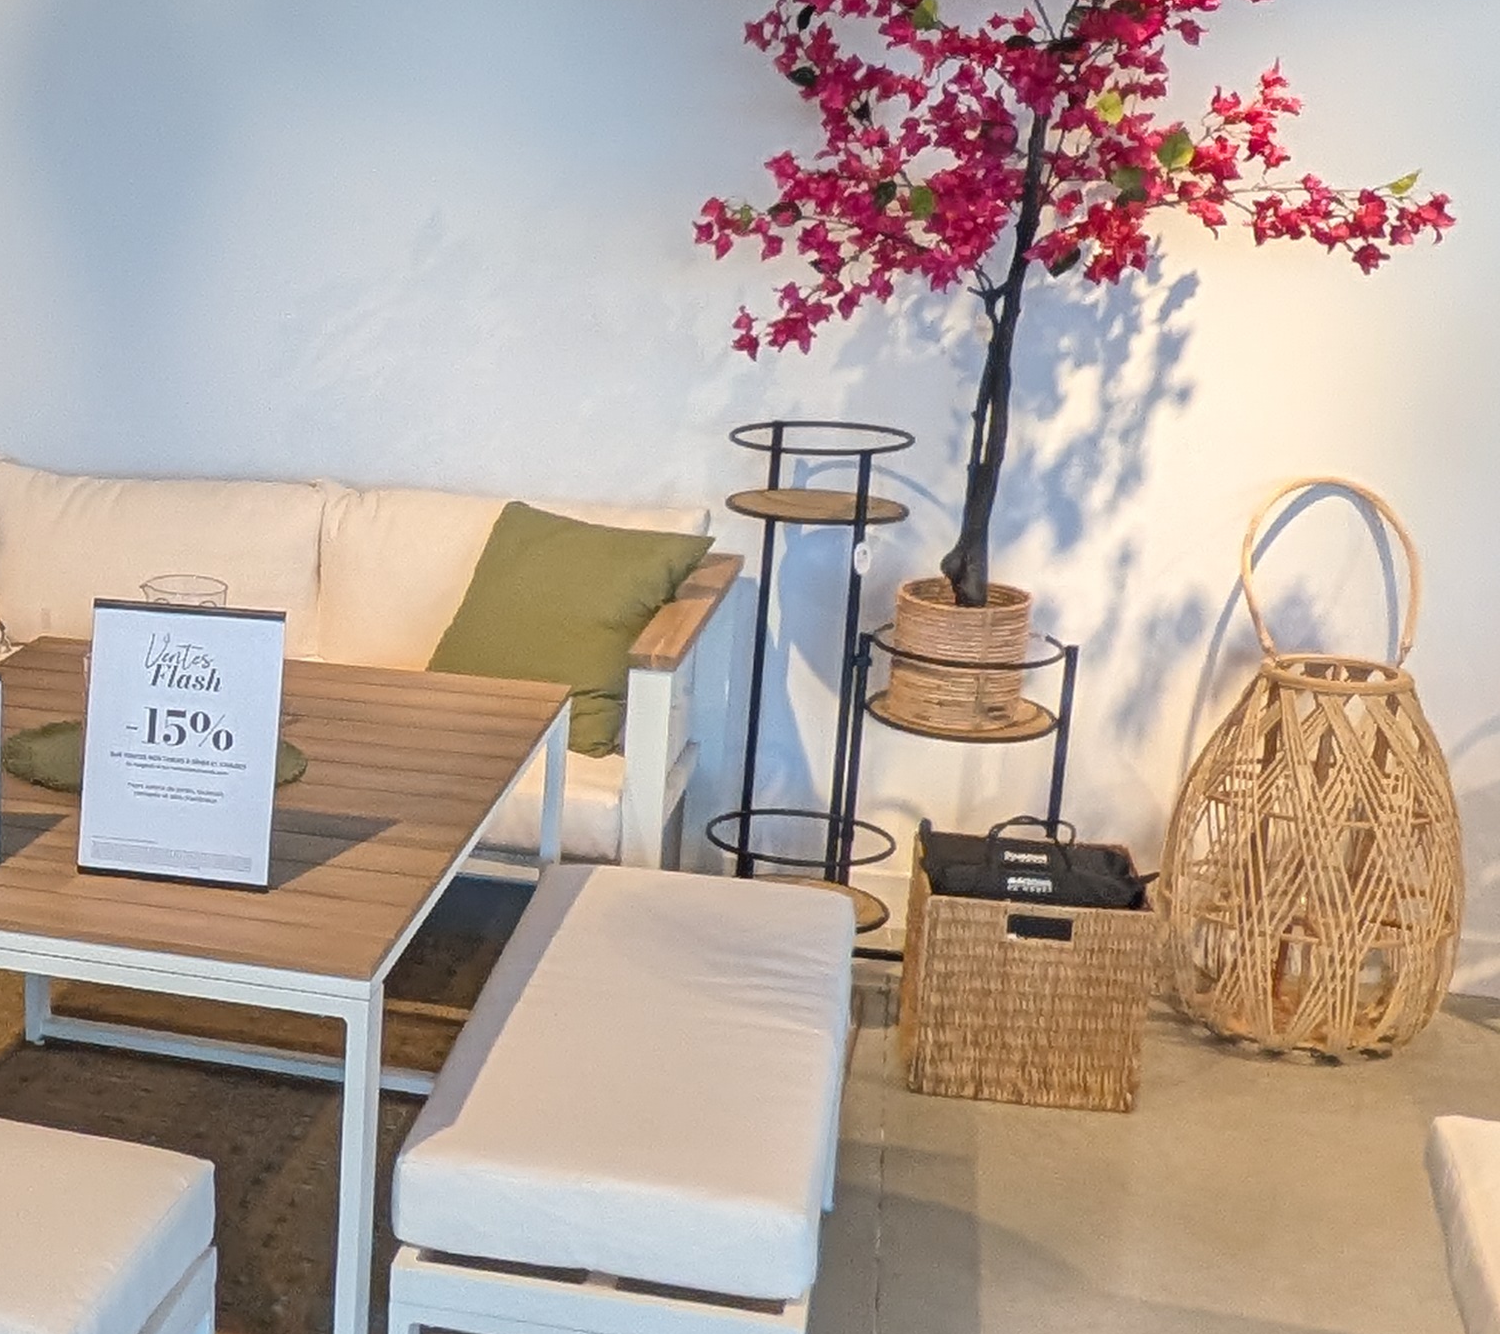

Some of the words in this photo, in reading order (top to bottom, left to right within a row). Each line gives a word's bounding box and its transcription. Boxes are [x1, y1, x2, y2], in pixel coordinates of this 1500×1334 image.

[145, 633, 213, 670] Ventes
[150, 663, 222, 692] Flash
[125, 706, 234, 752] -15%
